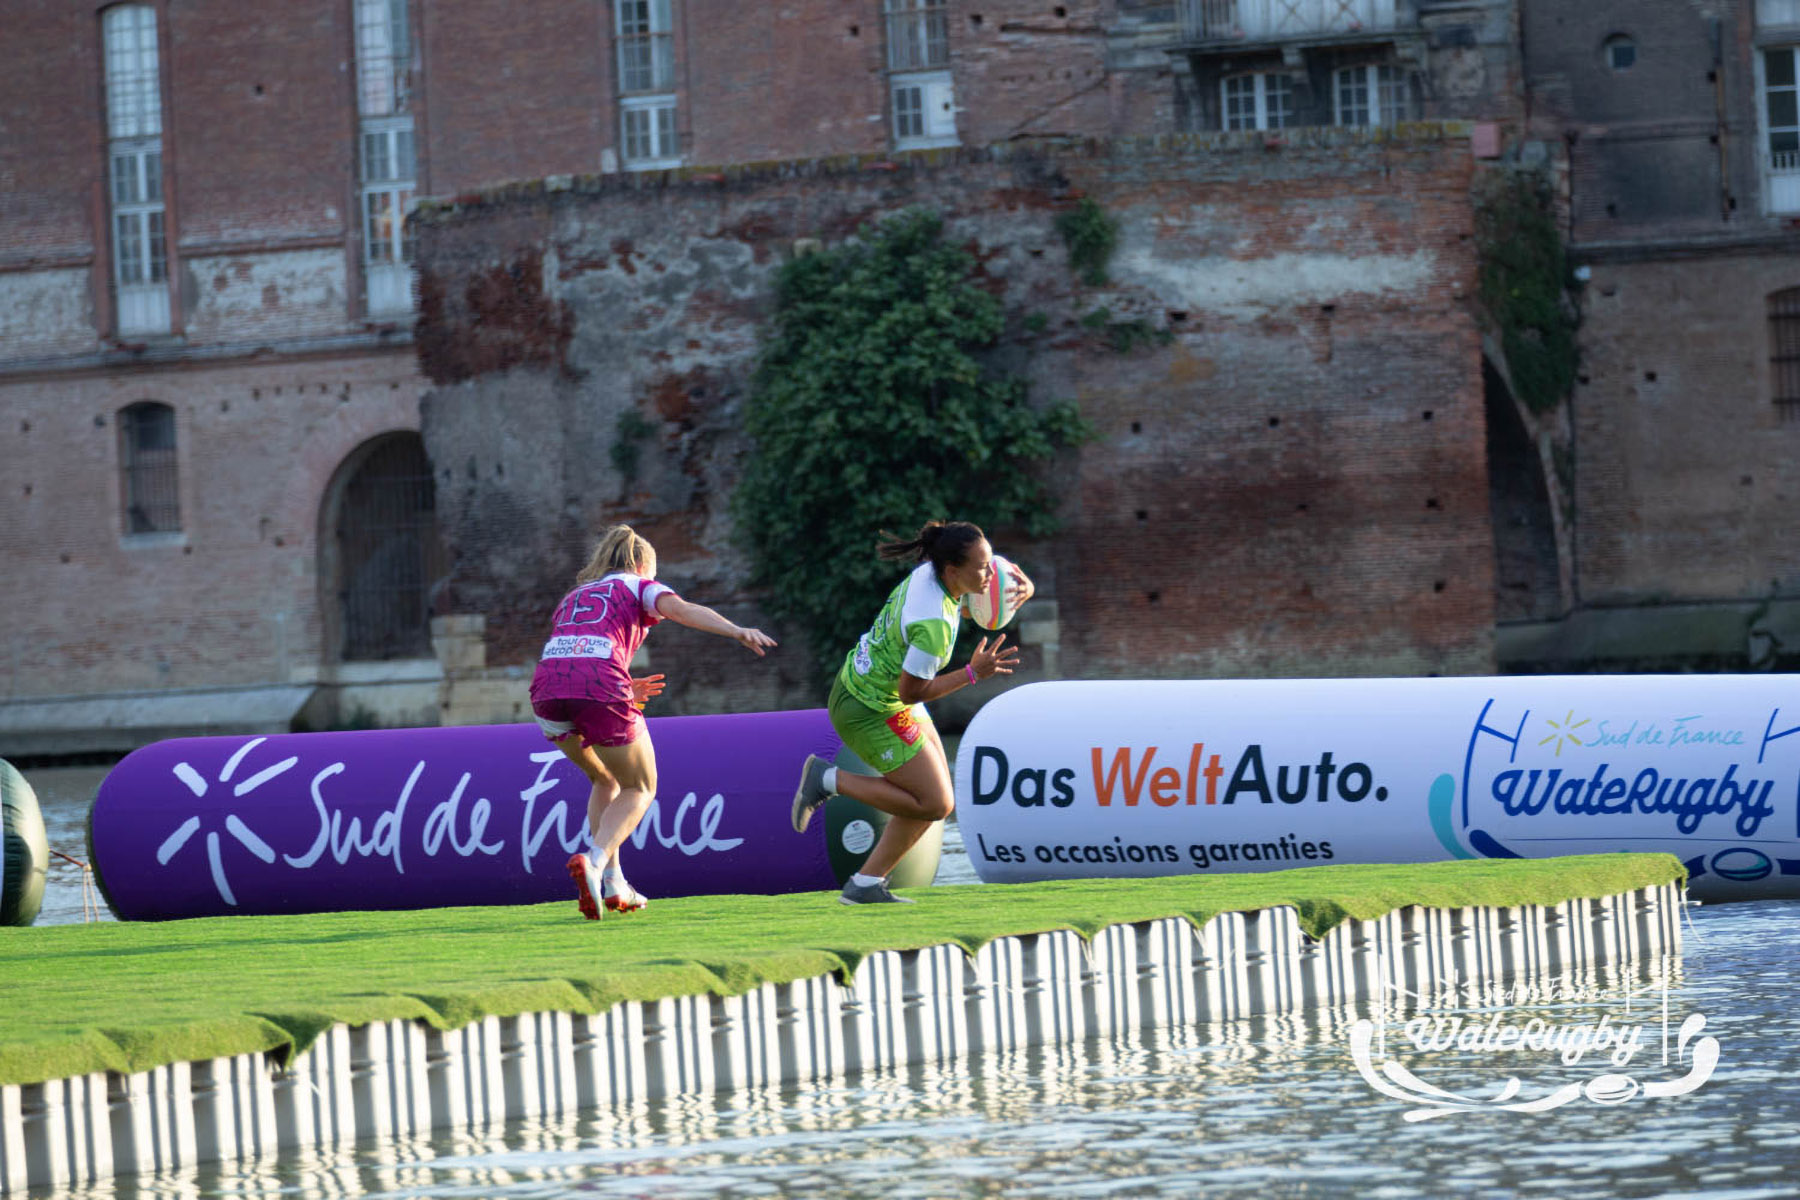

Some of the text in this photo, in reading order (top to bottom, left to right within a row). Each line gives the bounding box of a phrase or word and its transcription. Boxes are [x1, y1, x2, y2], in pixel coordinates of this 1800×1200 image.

[556, 583, 614, 627] 15
[1585, 714, 1748, 748] Sud de France
[972, 743, 1389, 808] Das WeltAuto.
[1492, 764, 1775, 837] WateRugby
[283, 762, 425, 874] Sud
[423, 772, 504, 856] de
[977, 833, 1334, 869] Les occasions garanties
